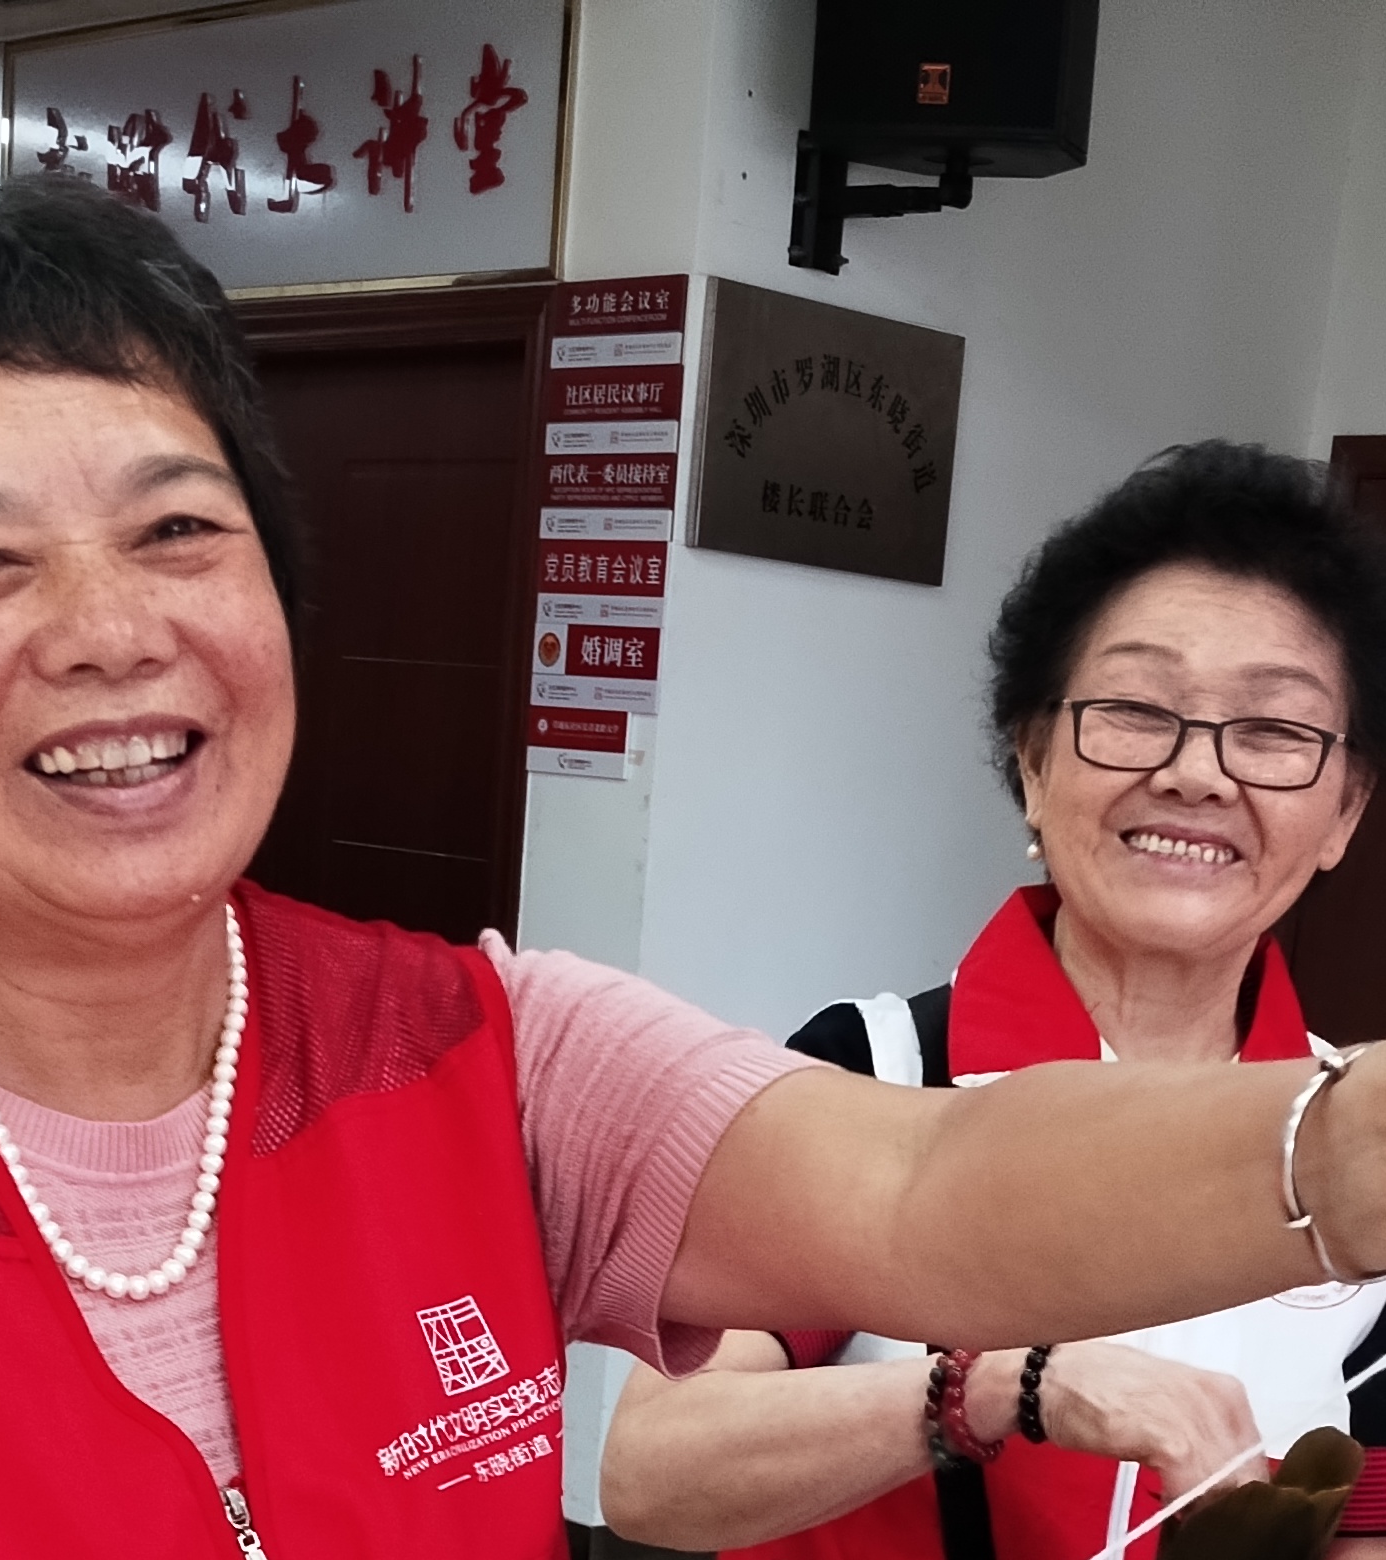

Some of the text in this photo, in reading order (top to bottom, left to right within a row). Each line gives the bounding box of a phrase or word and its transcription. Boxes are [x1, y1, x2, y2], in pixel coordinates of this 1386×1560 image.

[569, 289, 671, 315] 多功能会议室
[565, 382, 665, 406] 社区居民议事厅
[724, 353, 938, 493] 深圳市罗湖区东晓街道
[549, 463, 671, 485] 两代表一委员接待室
[761, 479, 874, 531] 楼长联合会
[544, 553, 662, 585] 党员教育会议室
[580, 635, 646, 668] 婚调室
[375, 1358, 562, 1478] 新时代文明实践志
[402, 1457, 430, 1481] NEW
[472, 1433, 554, 1484] 东晓街道
